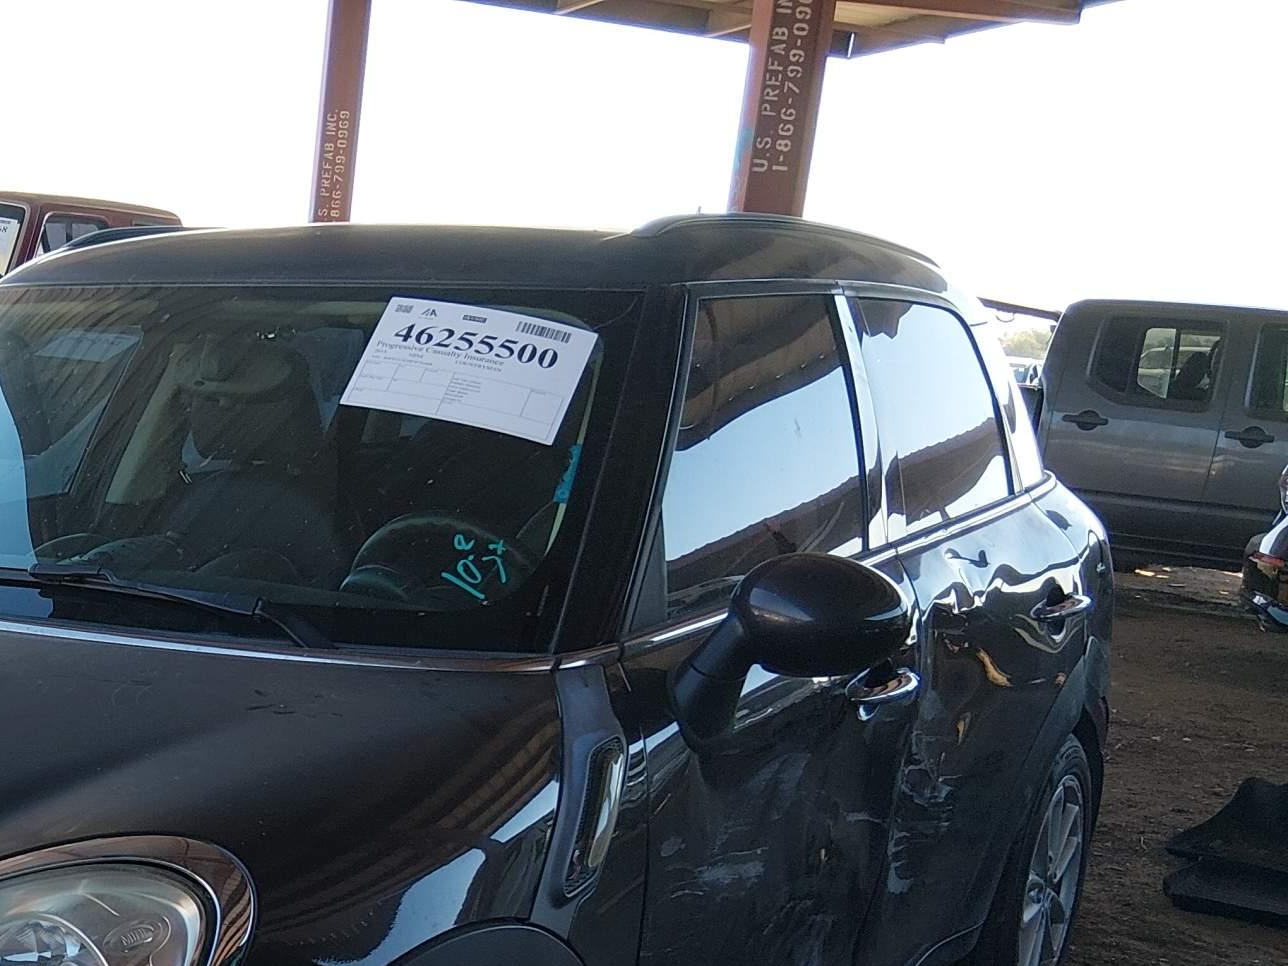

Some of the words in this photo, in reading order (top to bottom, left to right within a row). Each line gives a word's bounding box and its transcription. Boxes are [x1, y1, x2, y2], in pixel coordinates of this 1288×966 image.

[761, 27, 789, 116] PREFAB
[772, 0, 814, 172] 1-866-799-09
[326, 109, 339, 135] INC.
[320, 143, 335, 196] PREFAB
[330, 111, 351, 218] 866-799-0969
[752, 131, 774, 172] U.S.
[318, 204, 329, 221] .S.
[376, 340, 424, 354] Progressive
[425, 346, 462, 360] Casualty
[464, 353, 505, 366] Insurance
[394, 323, 559, 369] 46255500
